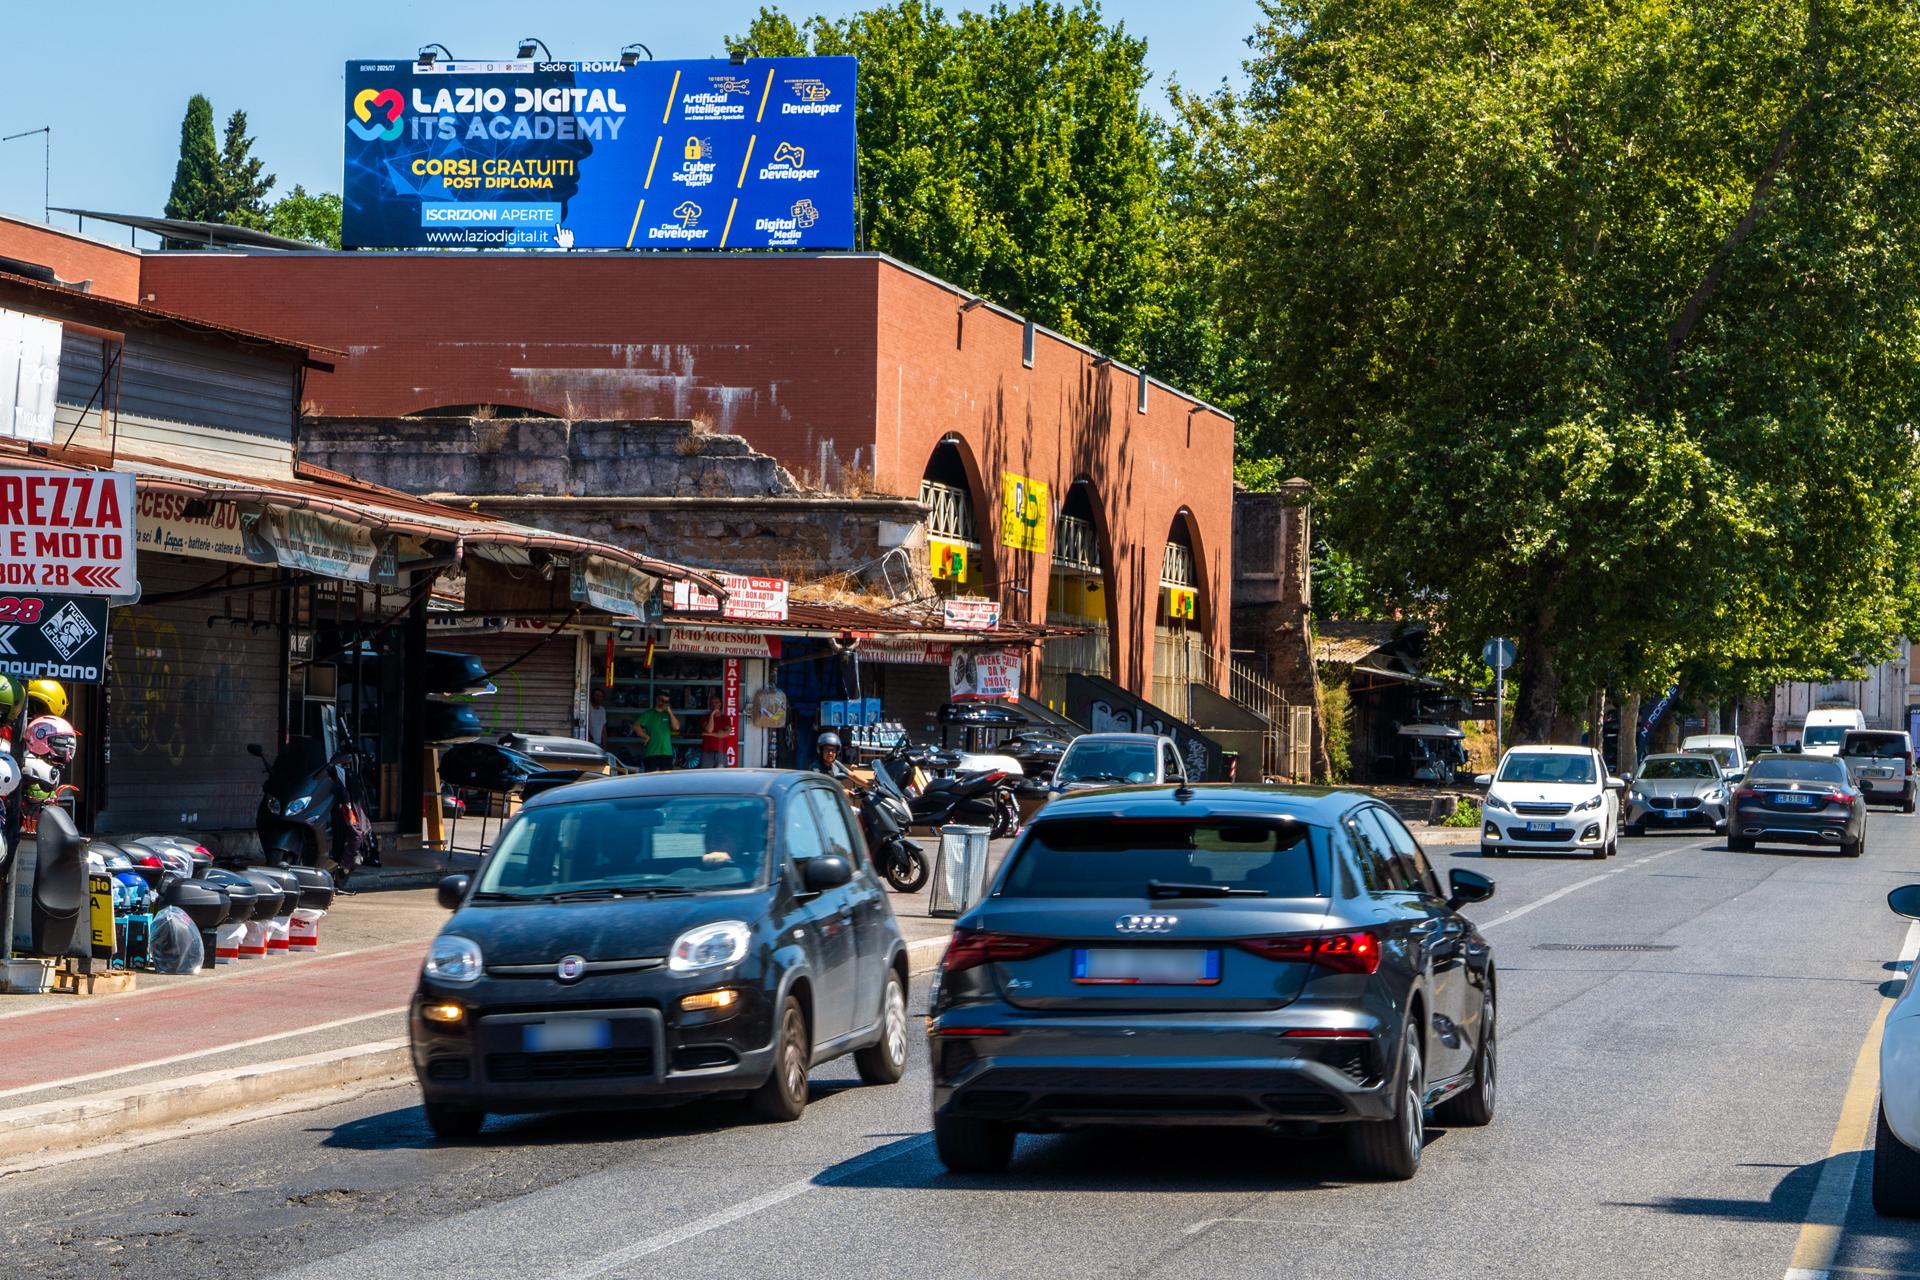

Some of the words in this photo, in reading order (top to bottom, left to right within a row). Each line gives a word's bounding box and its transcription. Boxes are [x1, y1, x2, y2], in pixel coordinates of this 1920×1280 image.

[539, 61, 567, 72] Sede
[568, 61, 580, 72] di
[582, 61, 626, 73] ROMA
[412, 88, 506, 113] LAZIO
[514, 88, 626, 113] DIGITAL
[683, 93, 728, 105] Artificial
[684, 104, 744, 115] Intelligence
[782, 102, 842, 116] Developer
[411, 116, 456, 140] ITS
[465, 116, 626, 140] ACADEMY
[411, 159, 477, 176] CORSI
[482, 159, 574, 176] GRATUITI
[682, 162, 716, 173] Cyber
[672, 172, 713, 183] Security
[759, 168, 820, 181] Developer
[443, 177, 482, 189] POST
[485, 177, 554, 189] DIPLOMA
[426, 209, 497, 221] ISCRIZIONI
[500, 209, 554, 221] APERTE
[755, 218, 796, 232] Digital
[426, 230, 549, 245] www.laziodigital.it
[649, 227, 709, 240] Developer
[774, 230, 802, 239] Media
[0, 476, 122, 528] REZZA
[10, 531, 27, 557] E
[35, 531, 122, 560] MOTO
[142, 530, 152, 543] sci
[188, 536, 210, 551] batterie
[214, 541, 234, 553] catene
[234, 543, 241, 555] da
[41, 564, 69, 586] 28
[726, 577, 747, 589] AUTO
[752, 580, 772, 589] BOX
[774, 580, 782, 589] 2
[745, 591, 757, 599] BOX
[758, 592, 774, 600] AUTO
[0, 596, 44, 624] 28
[729, 600, 765, 609] PORTATUTTO
[674, 628, 700, 641] AUTO
[703, 630, 761, 645] ACCESSORI
[672, 643, 700, 652] BATTERIE
[704, 645, 719, 654] AUTO
[725, 647, 768, 657] PORTAPACCHI
[925, 653, 943, 664] AUTO
[976, 655, 1000, 666] CATENE
[1002, 655, 1018, 668] CALZE
[987, 666, 998, 676] DA
